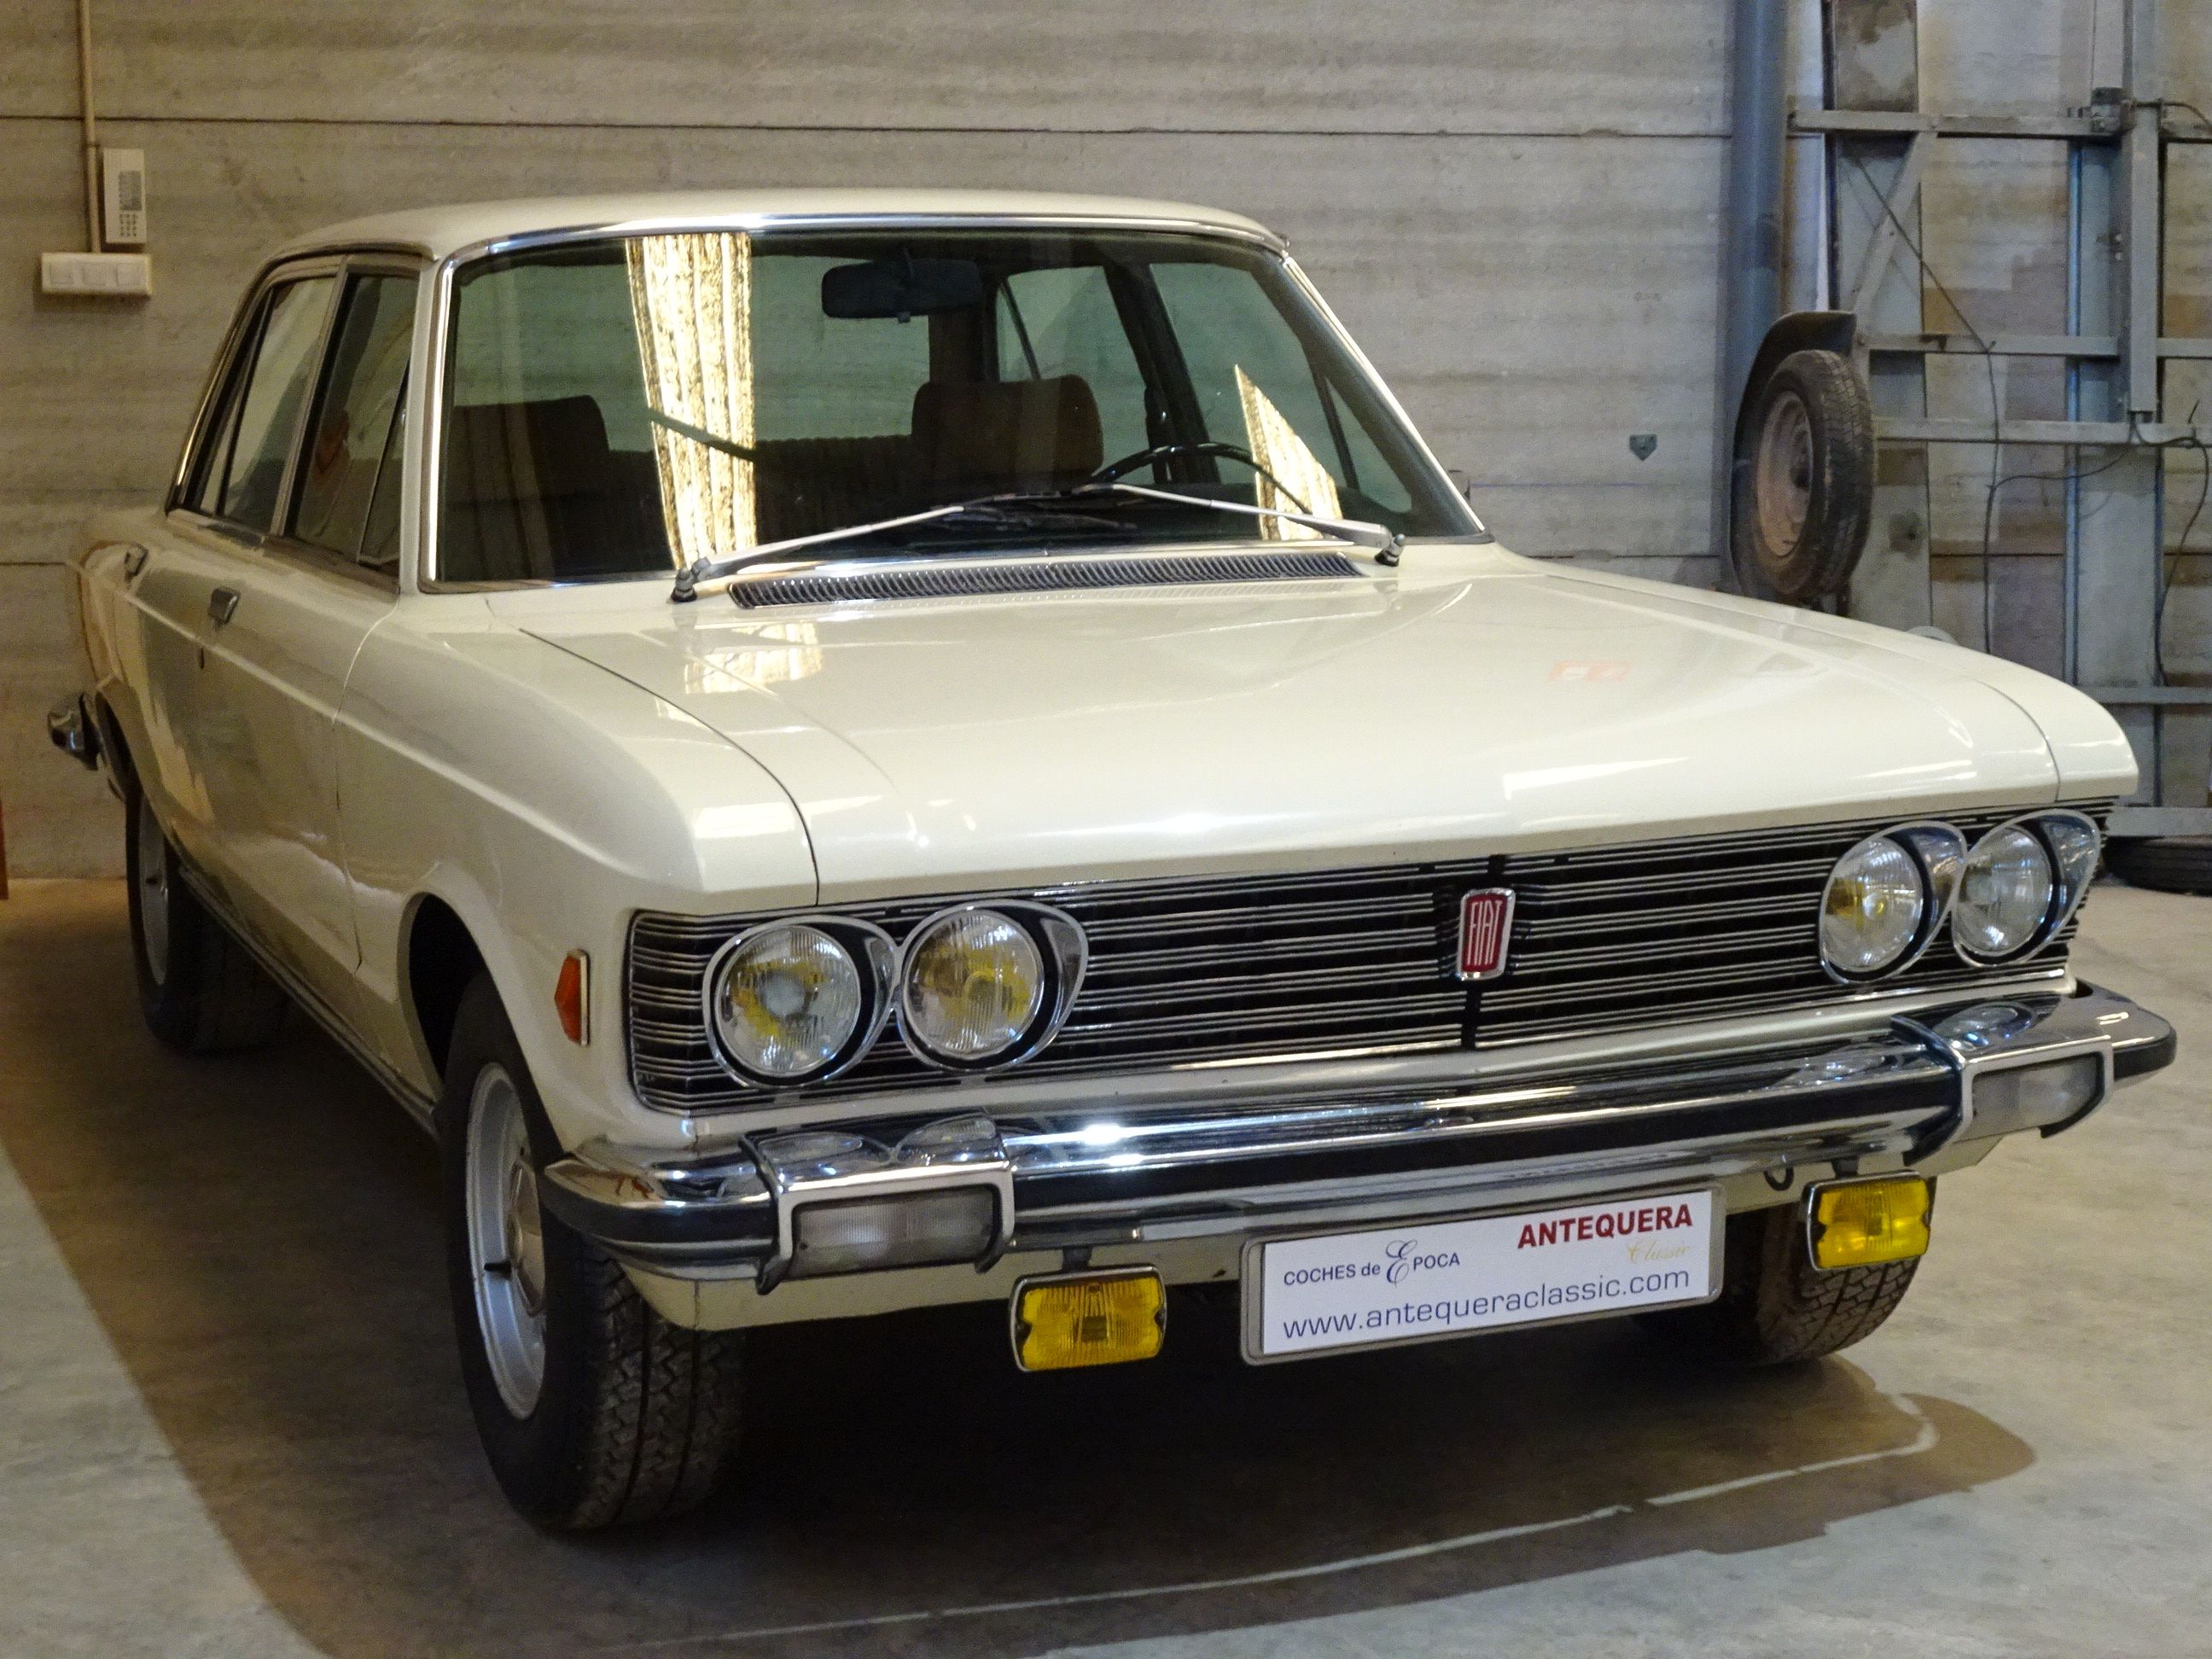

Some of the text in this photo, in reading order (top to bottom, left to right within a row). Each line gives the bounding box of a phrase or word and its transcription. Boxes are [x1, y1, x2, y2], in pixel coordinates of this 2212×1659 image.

[1466, 899, 1504, 966] FIAT
[1518, 1203, 1692, 1249] ANTEQUERA
[1283, 1265, 1357, 1286] COCHES
[1360, 1261, 1382, 1278] de
[1283, 1269, 1691, 1339] www.antequeraclassic.com
